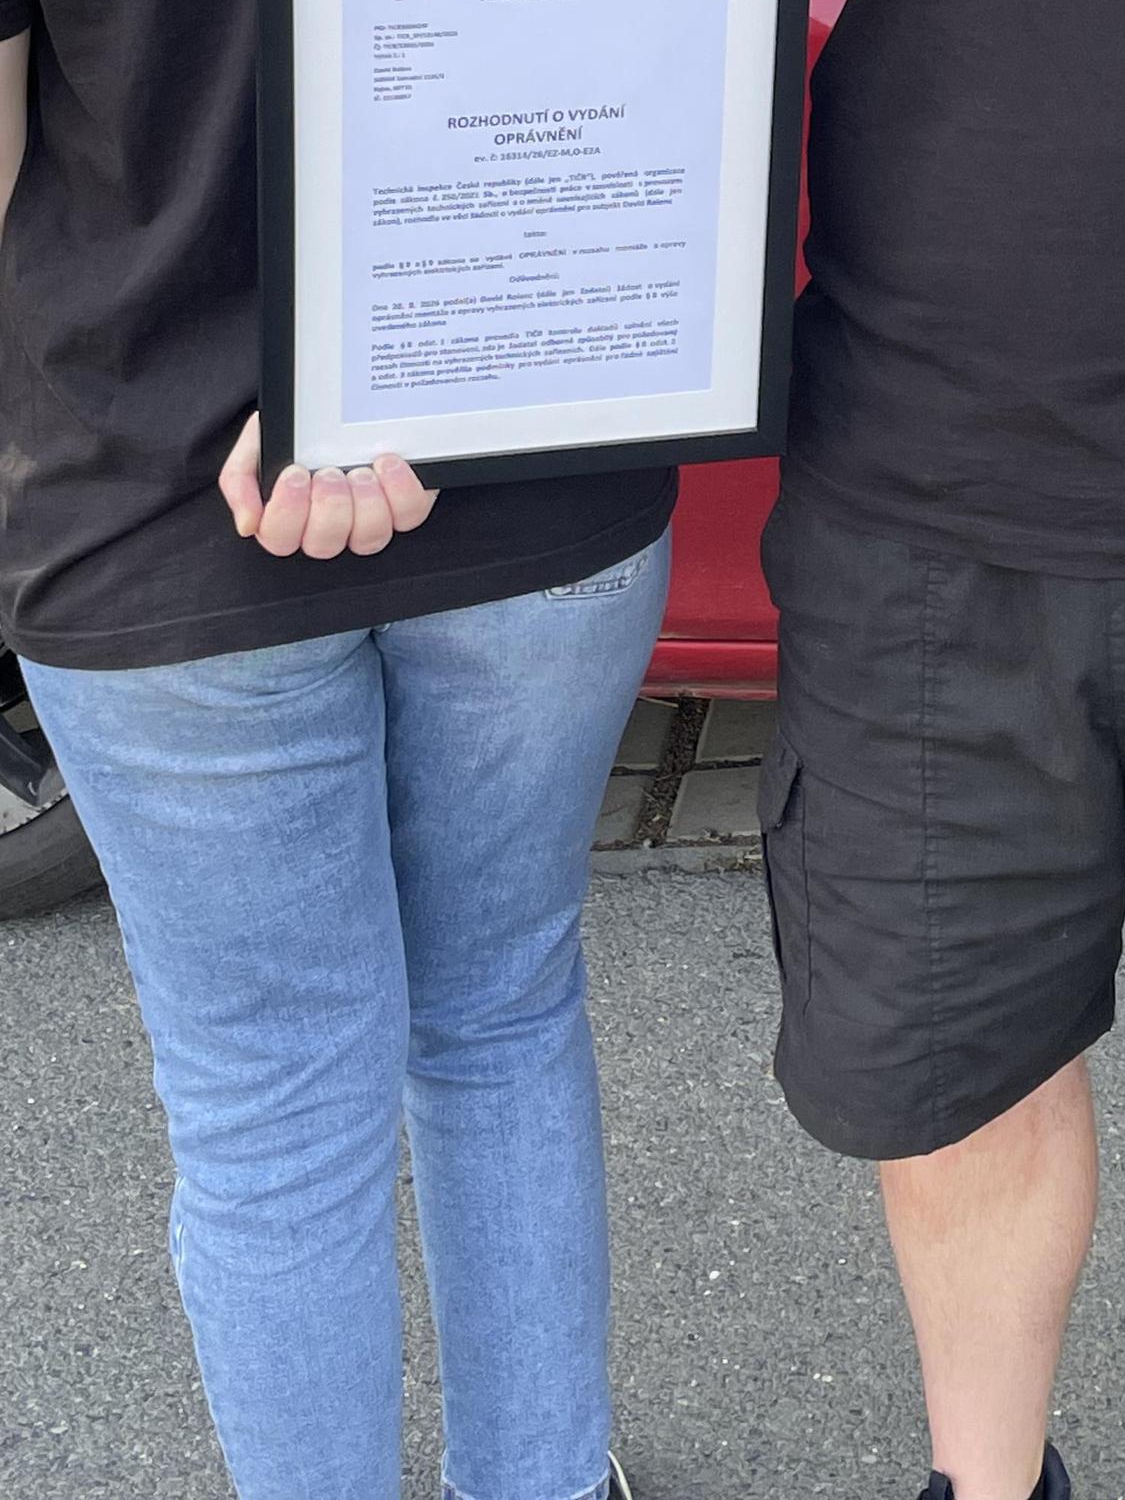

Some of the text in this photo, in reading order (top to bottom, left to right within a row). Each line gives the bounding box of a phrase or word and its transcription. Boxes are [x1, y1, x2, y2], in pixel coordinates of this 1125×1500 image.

[447, 103, 625, 129] ROZHODNUTÍ O VYDÁNÍ
[493, 125, 582, 145] OPRÁVNĚNÍ
